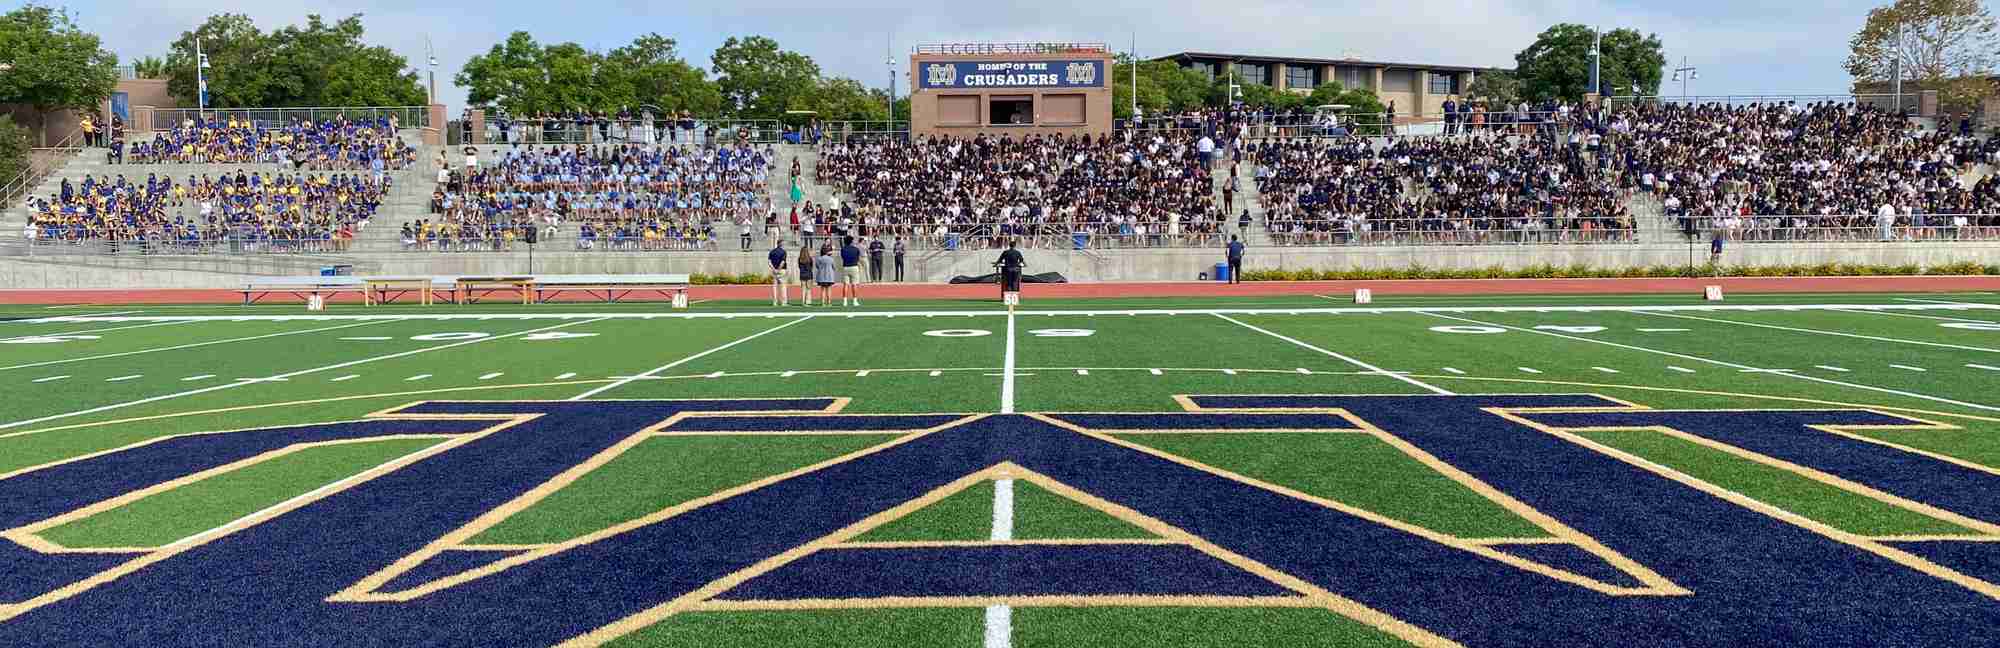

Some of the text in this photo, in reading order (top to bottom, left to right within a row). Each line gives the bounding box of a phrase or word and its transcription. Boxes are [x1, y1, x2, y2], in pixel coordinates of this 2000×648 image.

[978, 63, 1006, 71] HOME
[964, 73, 1058, 85] CRUSADERS
[309, 294, 322, 309] 30
[672, 294, 686, 307] 40
